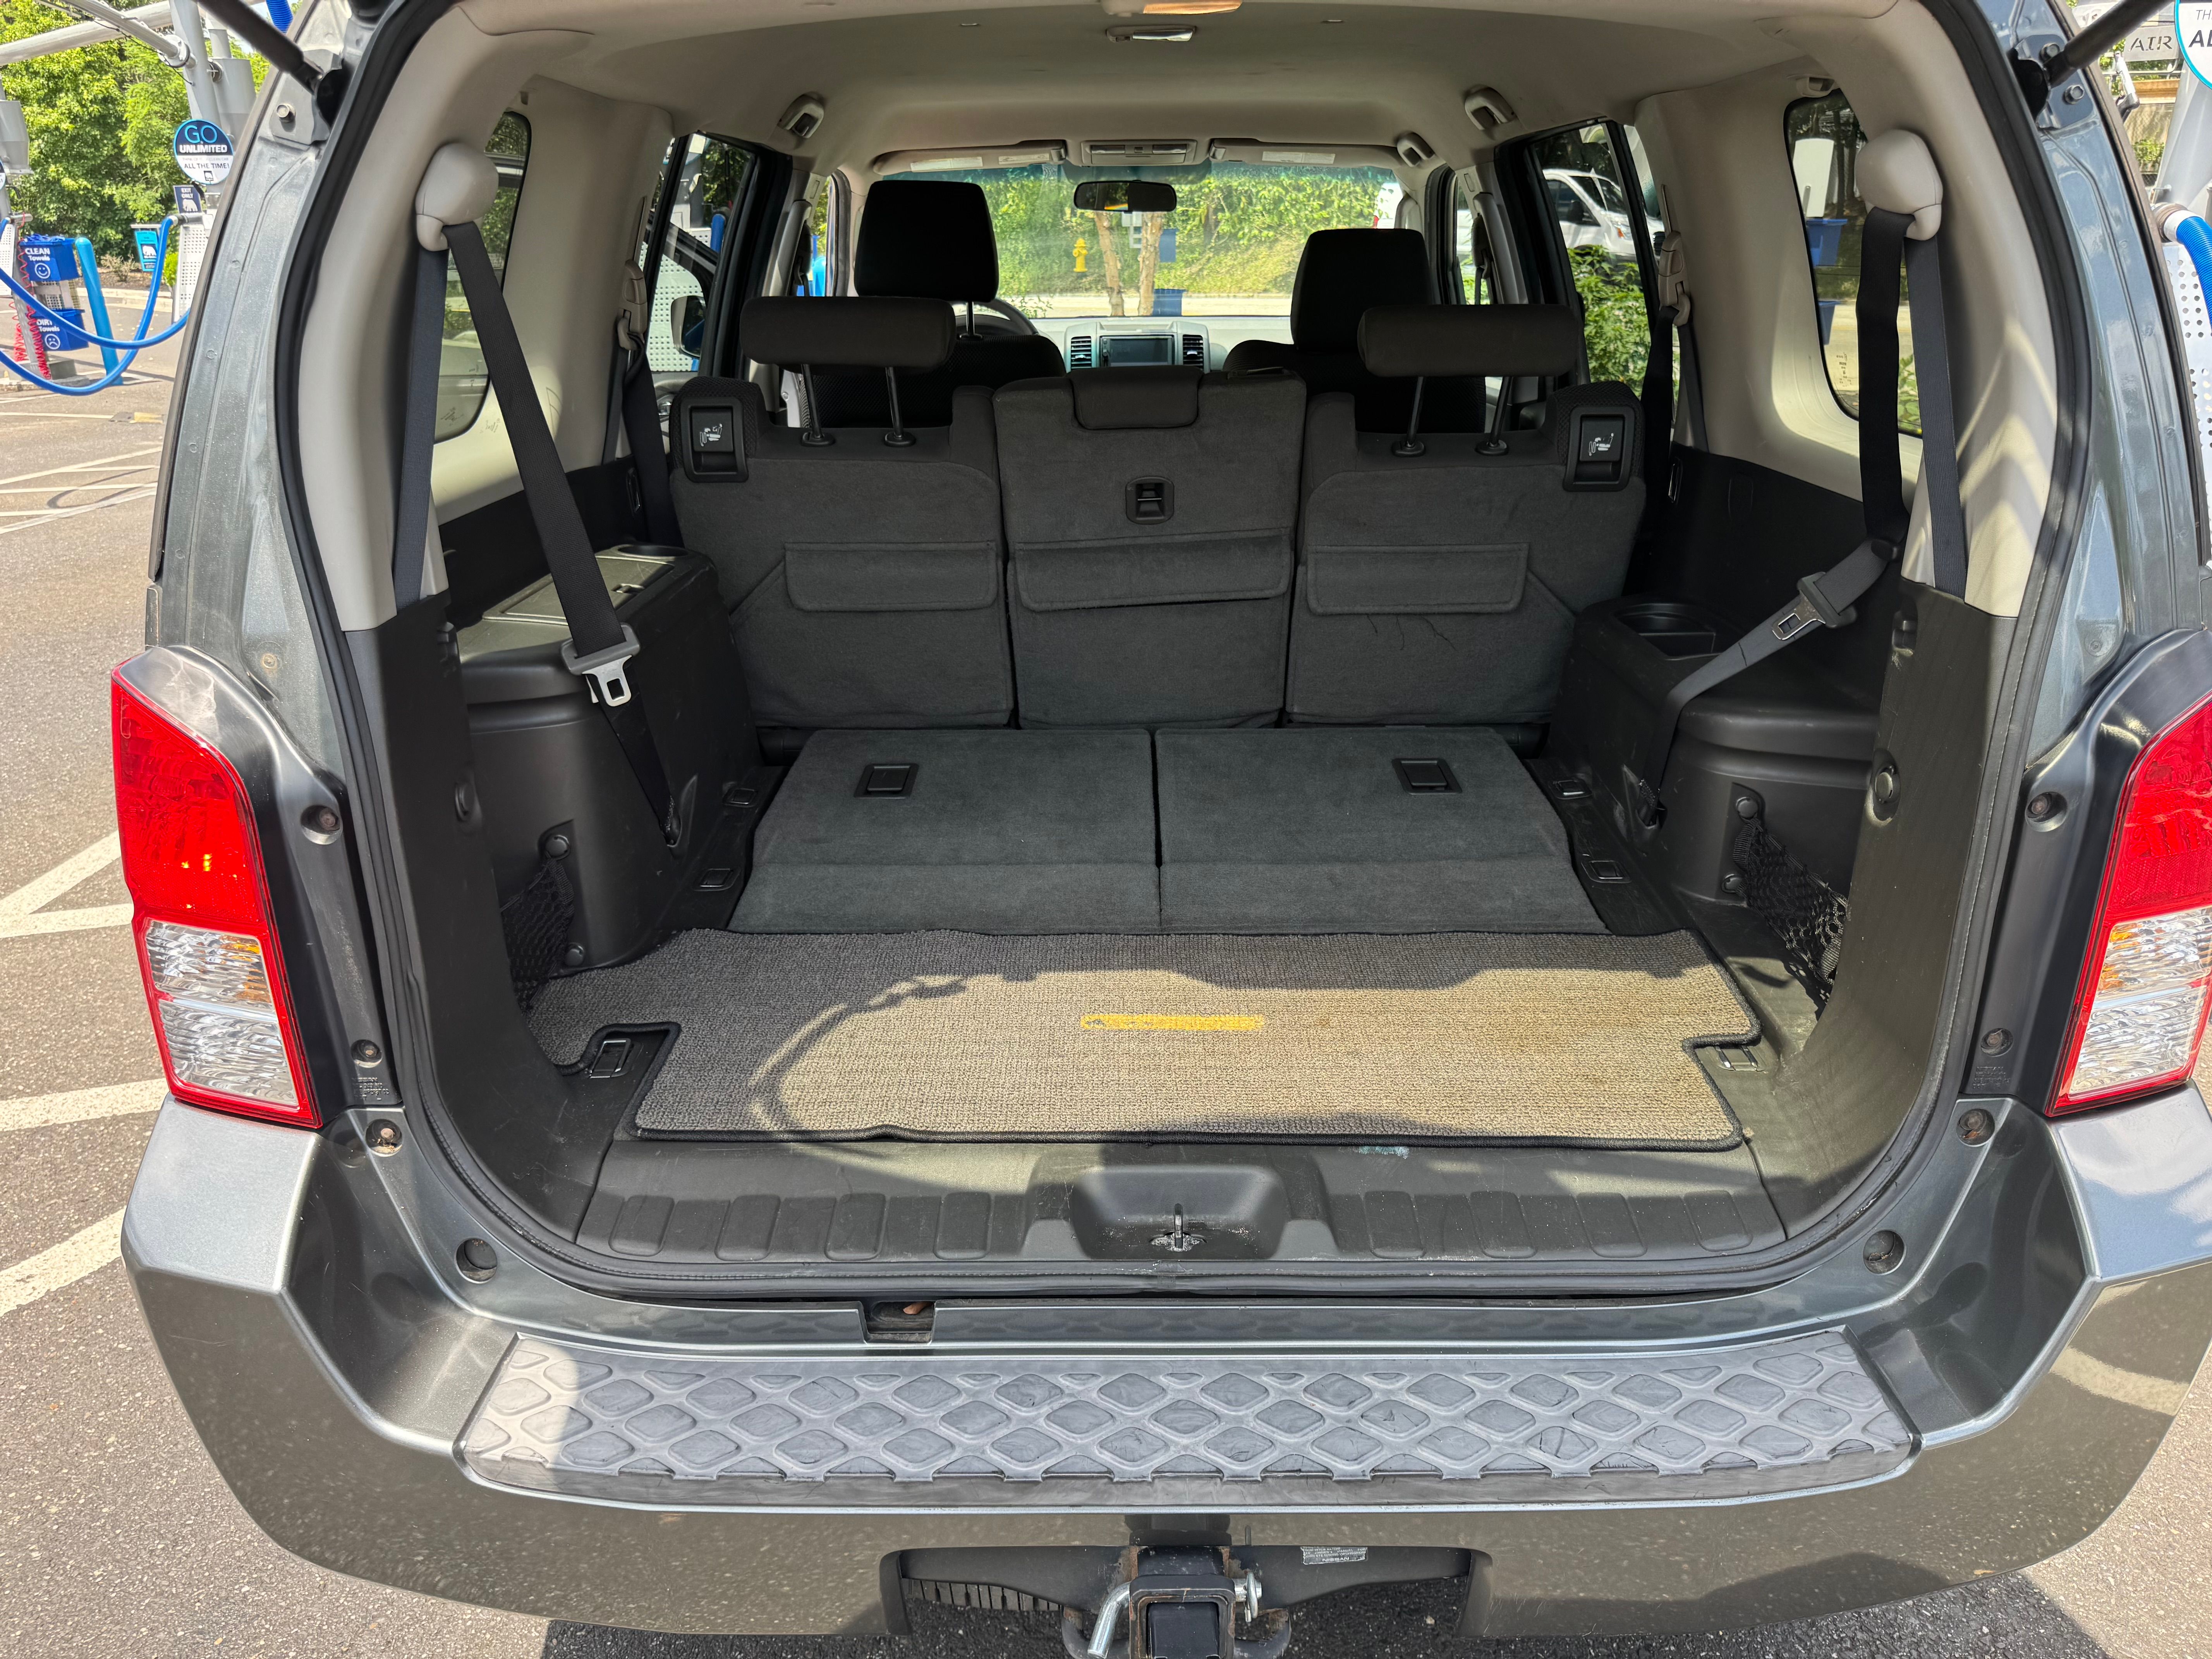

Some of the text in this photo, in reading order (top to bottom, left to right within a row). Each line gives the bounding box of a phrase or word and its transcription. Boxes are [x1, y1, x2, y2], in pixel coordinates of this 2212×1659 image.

[2196, 9, 2212, 20] TH
[2128, 36, 2172, 51] AIR
[185, 125, 217, 143] GO
[179, 144, 228, 153] UNLIMITED
